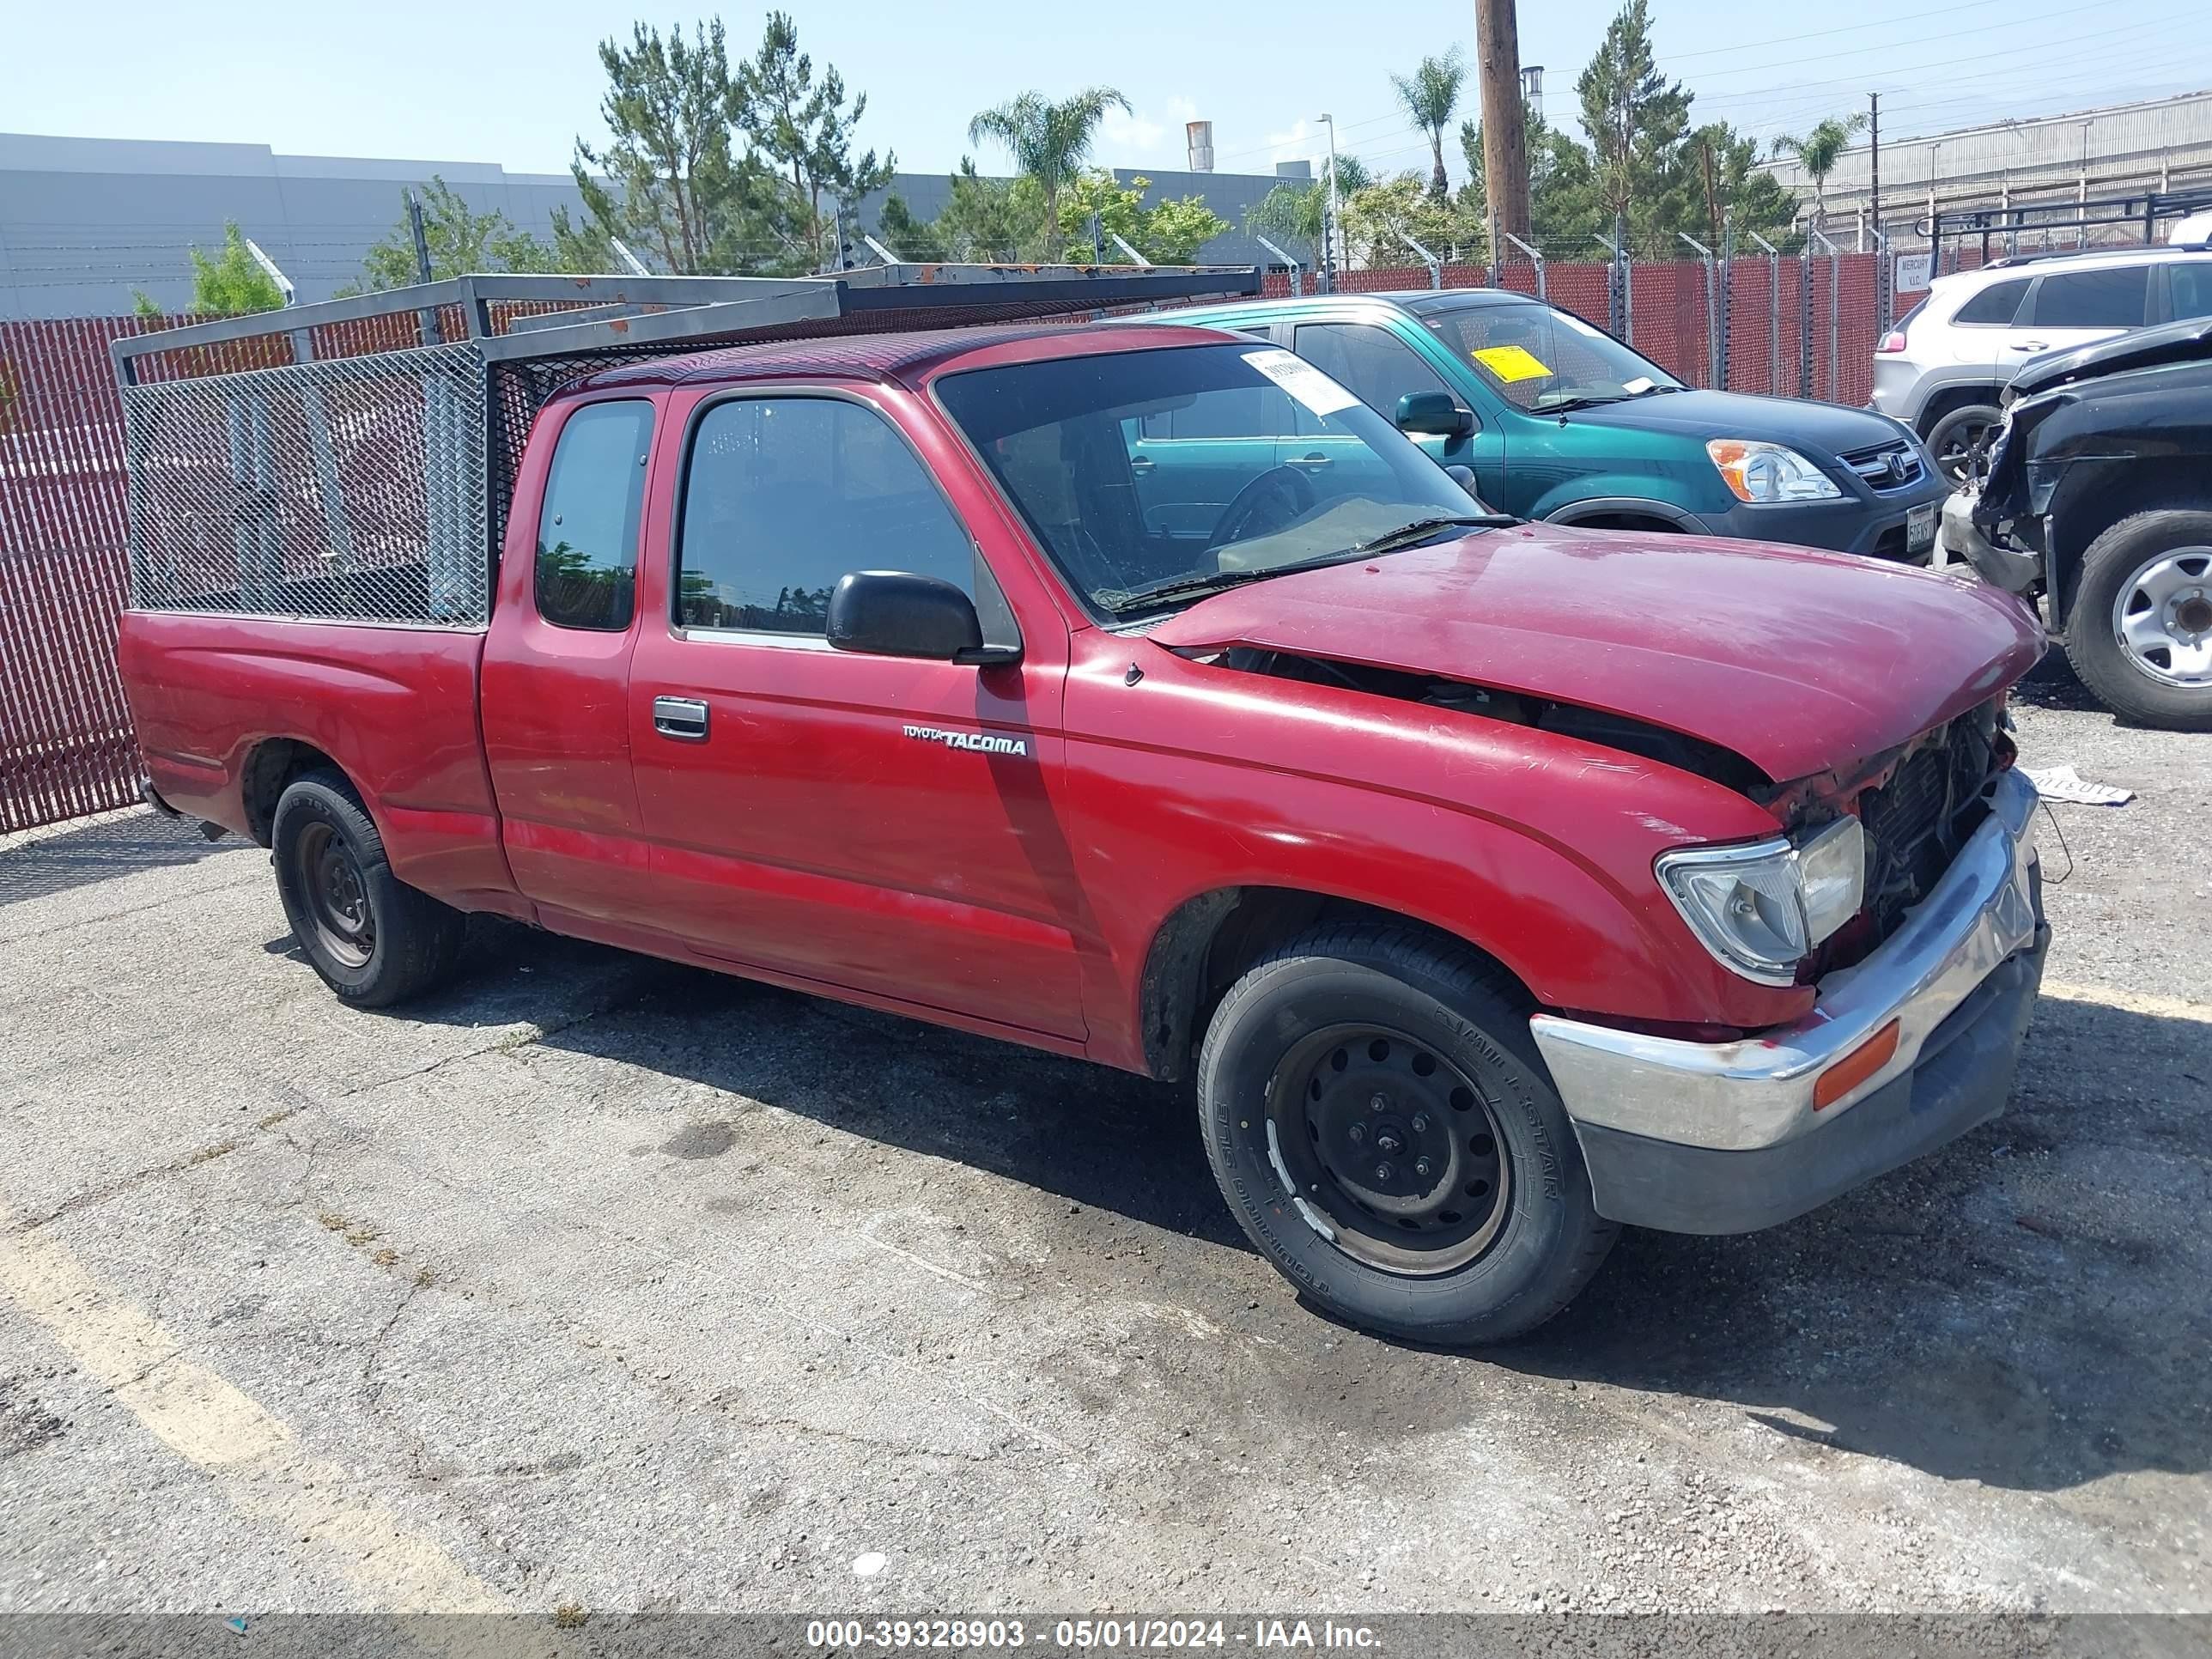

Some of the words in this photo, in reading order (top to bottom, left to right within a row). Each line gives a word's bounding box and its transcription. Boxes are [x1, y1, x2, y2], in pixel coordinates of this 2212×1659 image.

[1902, 258, 1929, 270] MERCURY
[902, 725, 945, 740] TOYOTA
[945, 731, 1028, 757] TACOMA
